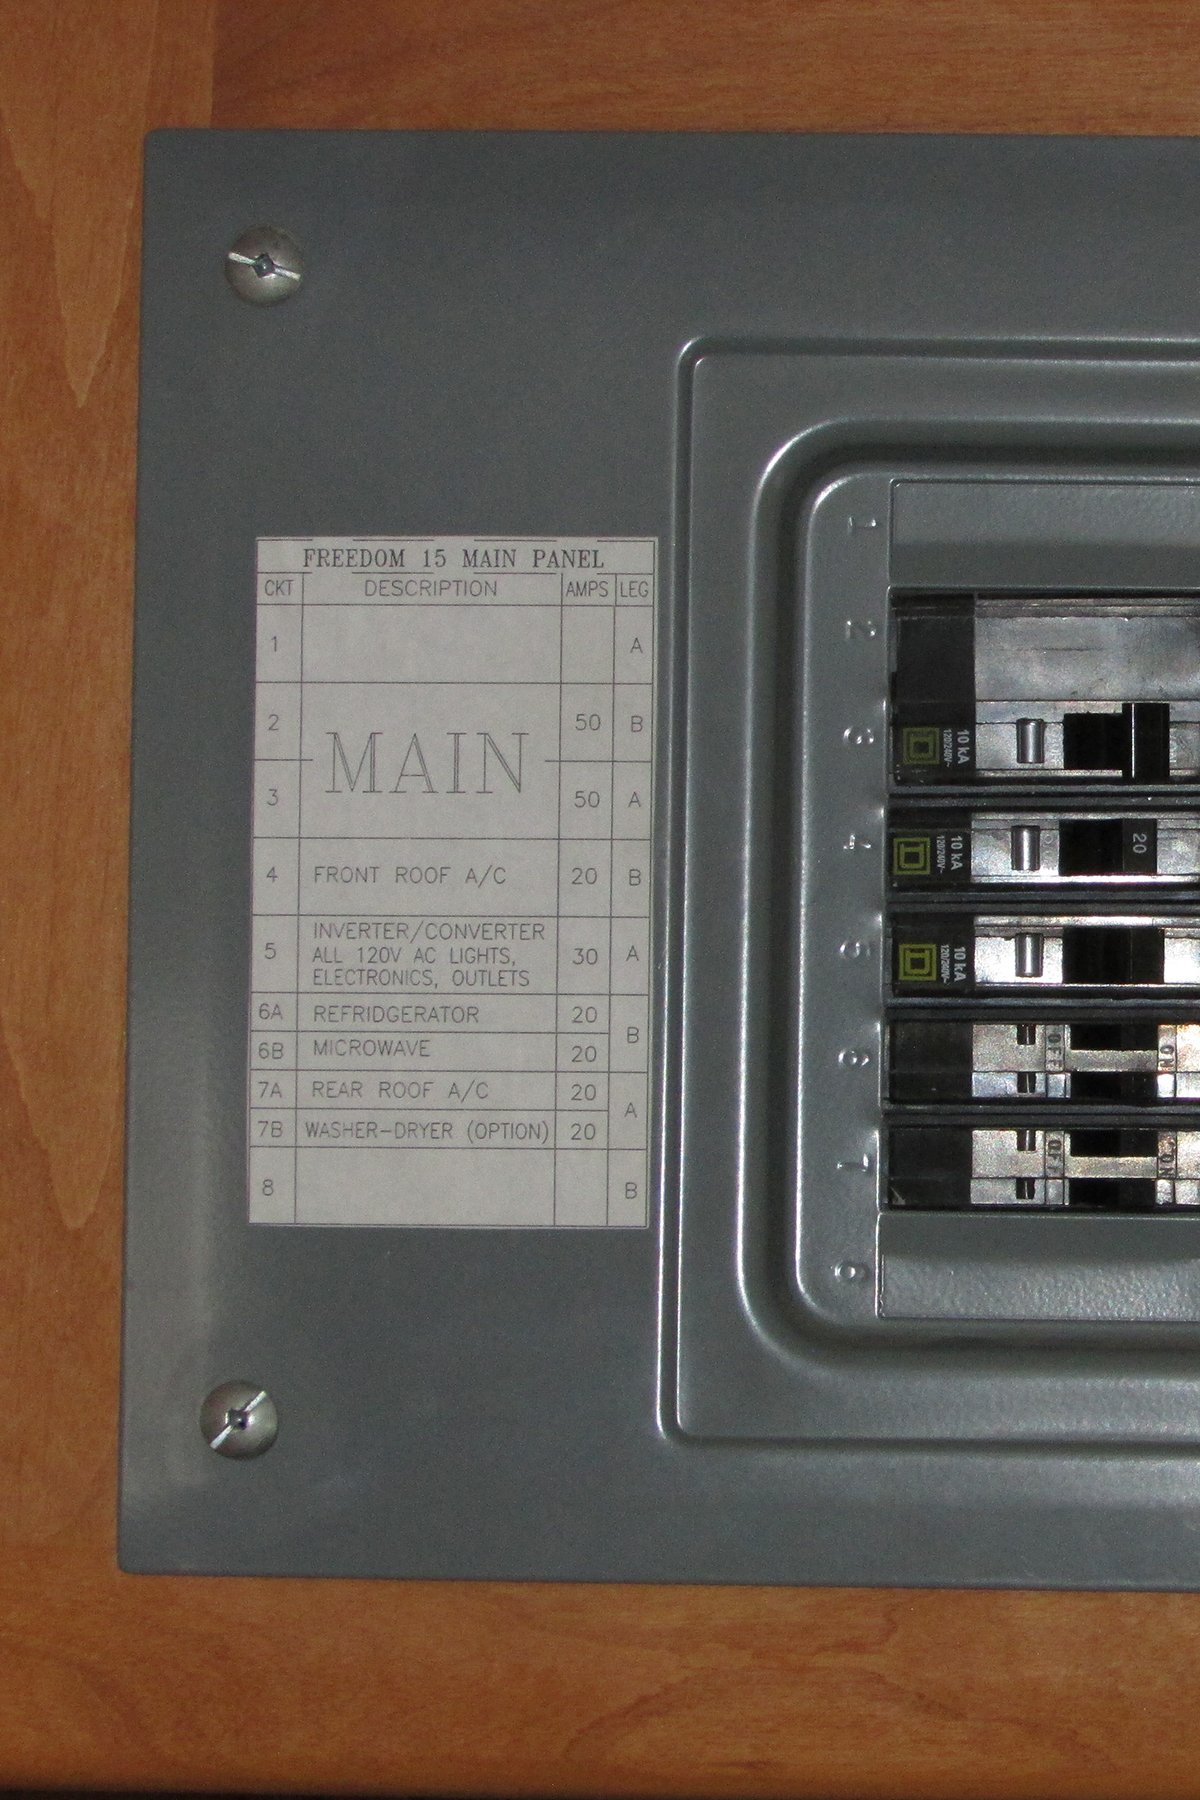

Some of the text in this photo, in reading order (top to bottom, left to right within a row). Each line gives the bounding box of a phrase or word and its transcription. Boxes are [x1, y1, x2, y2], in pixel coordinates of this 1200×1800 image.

[303, 549, 604, 568] FREEDOM 15 MAIN PANEL
[264, 580, 294, 596] CKT
[365, 580, 497, 597] DESCRIPTION
[565, 581, 609, 597] AMPS
[620, 581, 649, 597] LEG
[270, 637, 277, 652] 1
[630, 637, 643, 653] A
[268, 715, 279, 731] 2
[575, 714, 601, 731] 50
[631, 716, 643, 732] B
[957, 729, 970, 764] 10 kA
[325, 732, 529, 793] MAIN
[267, 789, 279, 805] 3
[574, 791, 600, 808] 50
[628, 792, 641, 808] A
[1132, 833, 1147, 854] 20
[951, 836, 963, 870] 10 kA
[266, 867, 278, 883] 4
[314, 866, 506, 885] FRONT ROOF A/C
[571, 867, 597, 885] 20
[629, 870, 641, 886] B
[313, 922, 544, 943] INVERTER/CONVERTER
[264, 943, 276, 959] 5
[312, 947, 515, 965] ALL 120V AC LIGHTS,
[572, 948, 598, 965] 30
[626, 945, 639, 961] A
[954, 947, 967, 982] 10 kA
[313, 969, 529, 988] ELECTRONICS, OUTLETS
[259, 1004, 283, 1020] 6A
[314, 1005, 479, 1023] REFRIDGERATOR
[572, 1006, 598, 1023] 20
[627, 1027, 639, 1043] B
[258, 1043, 284, 1059] 6B
[314, 1039, 431, 1057] MICROWAVE
[571, 1046, 597, 1063] 20
[258, 1082, 283, 1098] 7A
[312, 1081, 488, 1100] REAR ROOF A/C
[571, 1084, 597, 1101] 20
[624, 1102, 637, 1118] A
[258, 1121, 283, 1138] 7B
[305, 1122, 549, 1141] WASHER-DRYER (OPTION)
[571, 1123, 596, 1140] 20
[262, 1179, 274, 1196] 8
[625, 1182, 637, 1199] B
